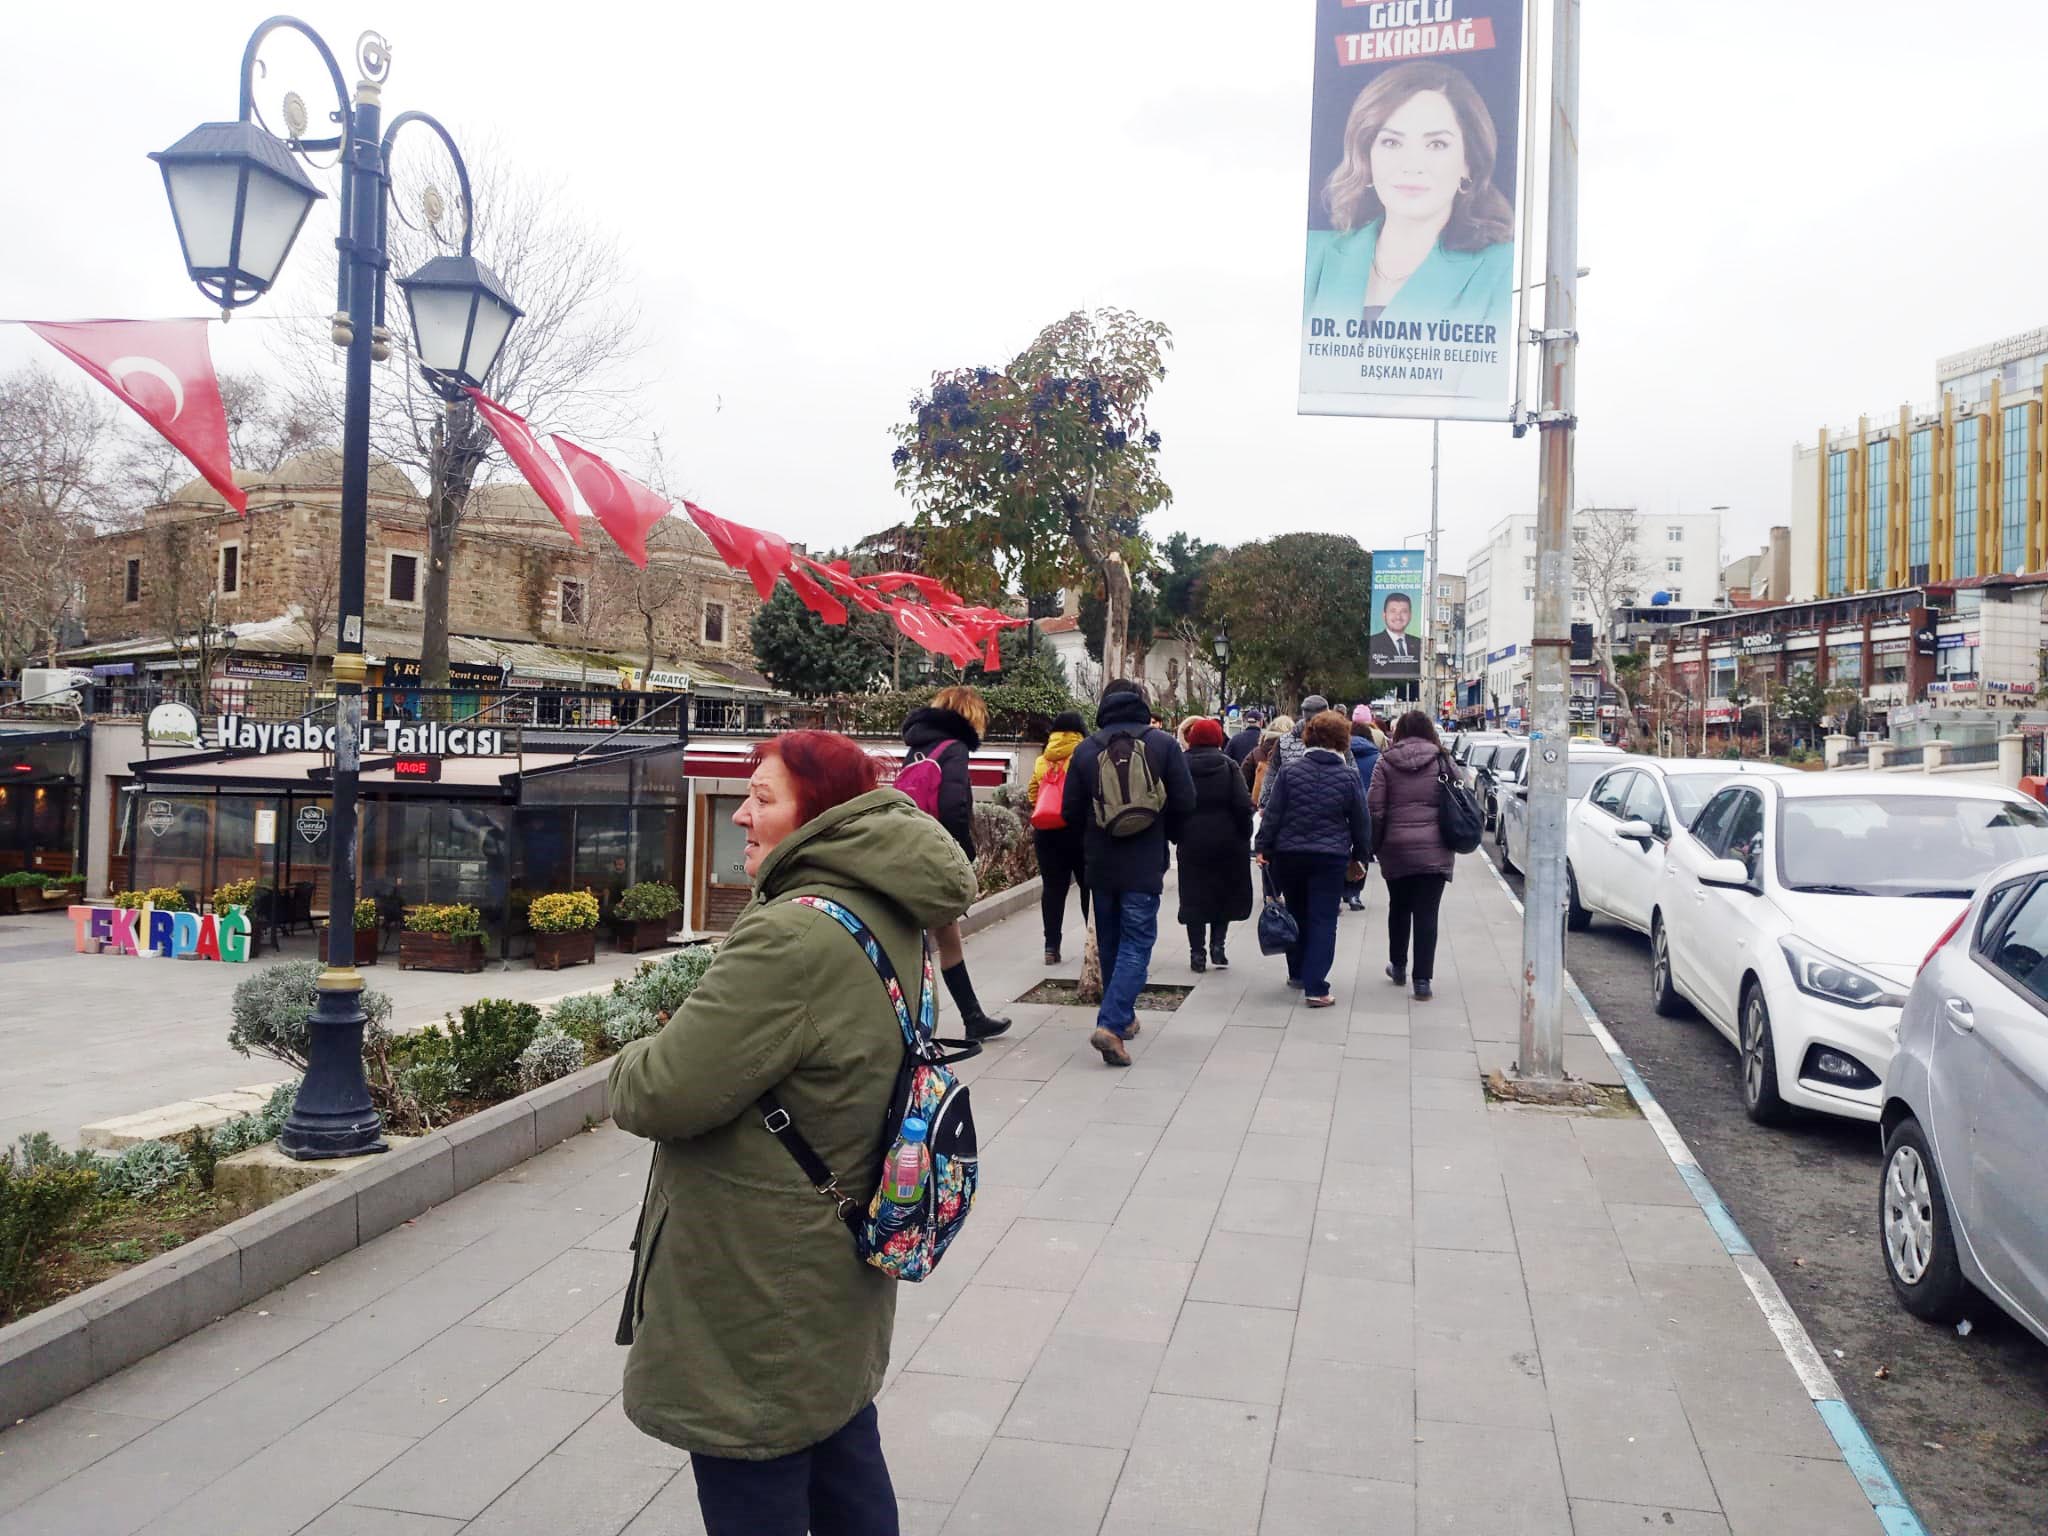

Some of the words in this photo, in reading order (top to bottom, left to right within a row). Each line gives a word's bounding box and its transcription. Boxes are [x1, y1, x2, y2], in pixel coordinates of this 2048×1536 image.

[1311, 317, 1340, 338] DR.
[1346, 319, 1422, 341] CANDAN
[1426, 320, 1496, 344] YÜCEER
[1308, 341, 1364, 359] TEKİRDAĞ
[1367, 343, 1440, 362] BÜYÜKŞEHİR
[1361, 364, 1406, 380] BAŞKAN
[1410, 367, 1443, 381] ADAYI
[473, 672, 480, 680] a
[217, 715, 371, 754] Hayrabou
[384, 719, 500, 755] Tatlıcısı
[68, 901, 252, 963] TEKİRDAĞ
